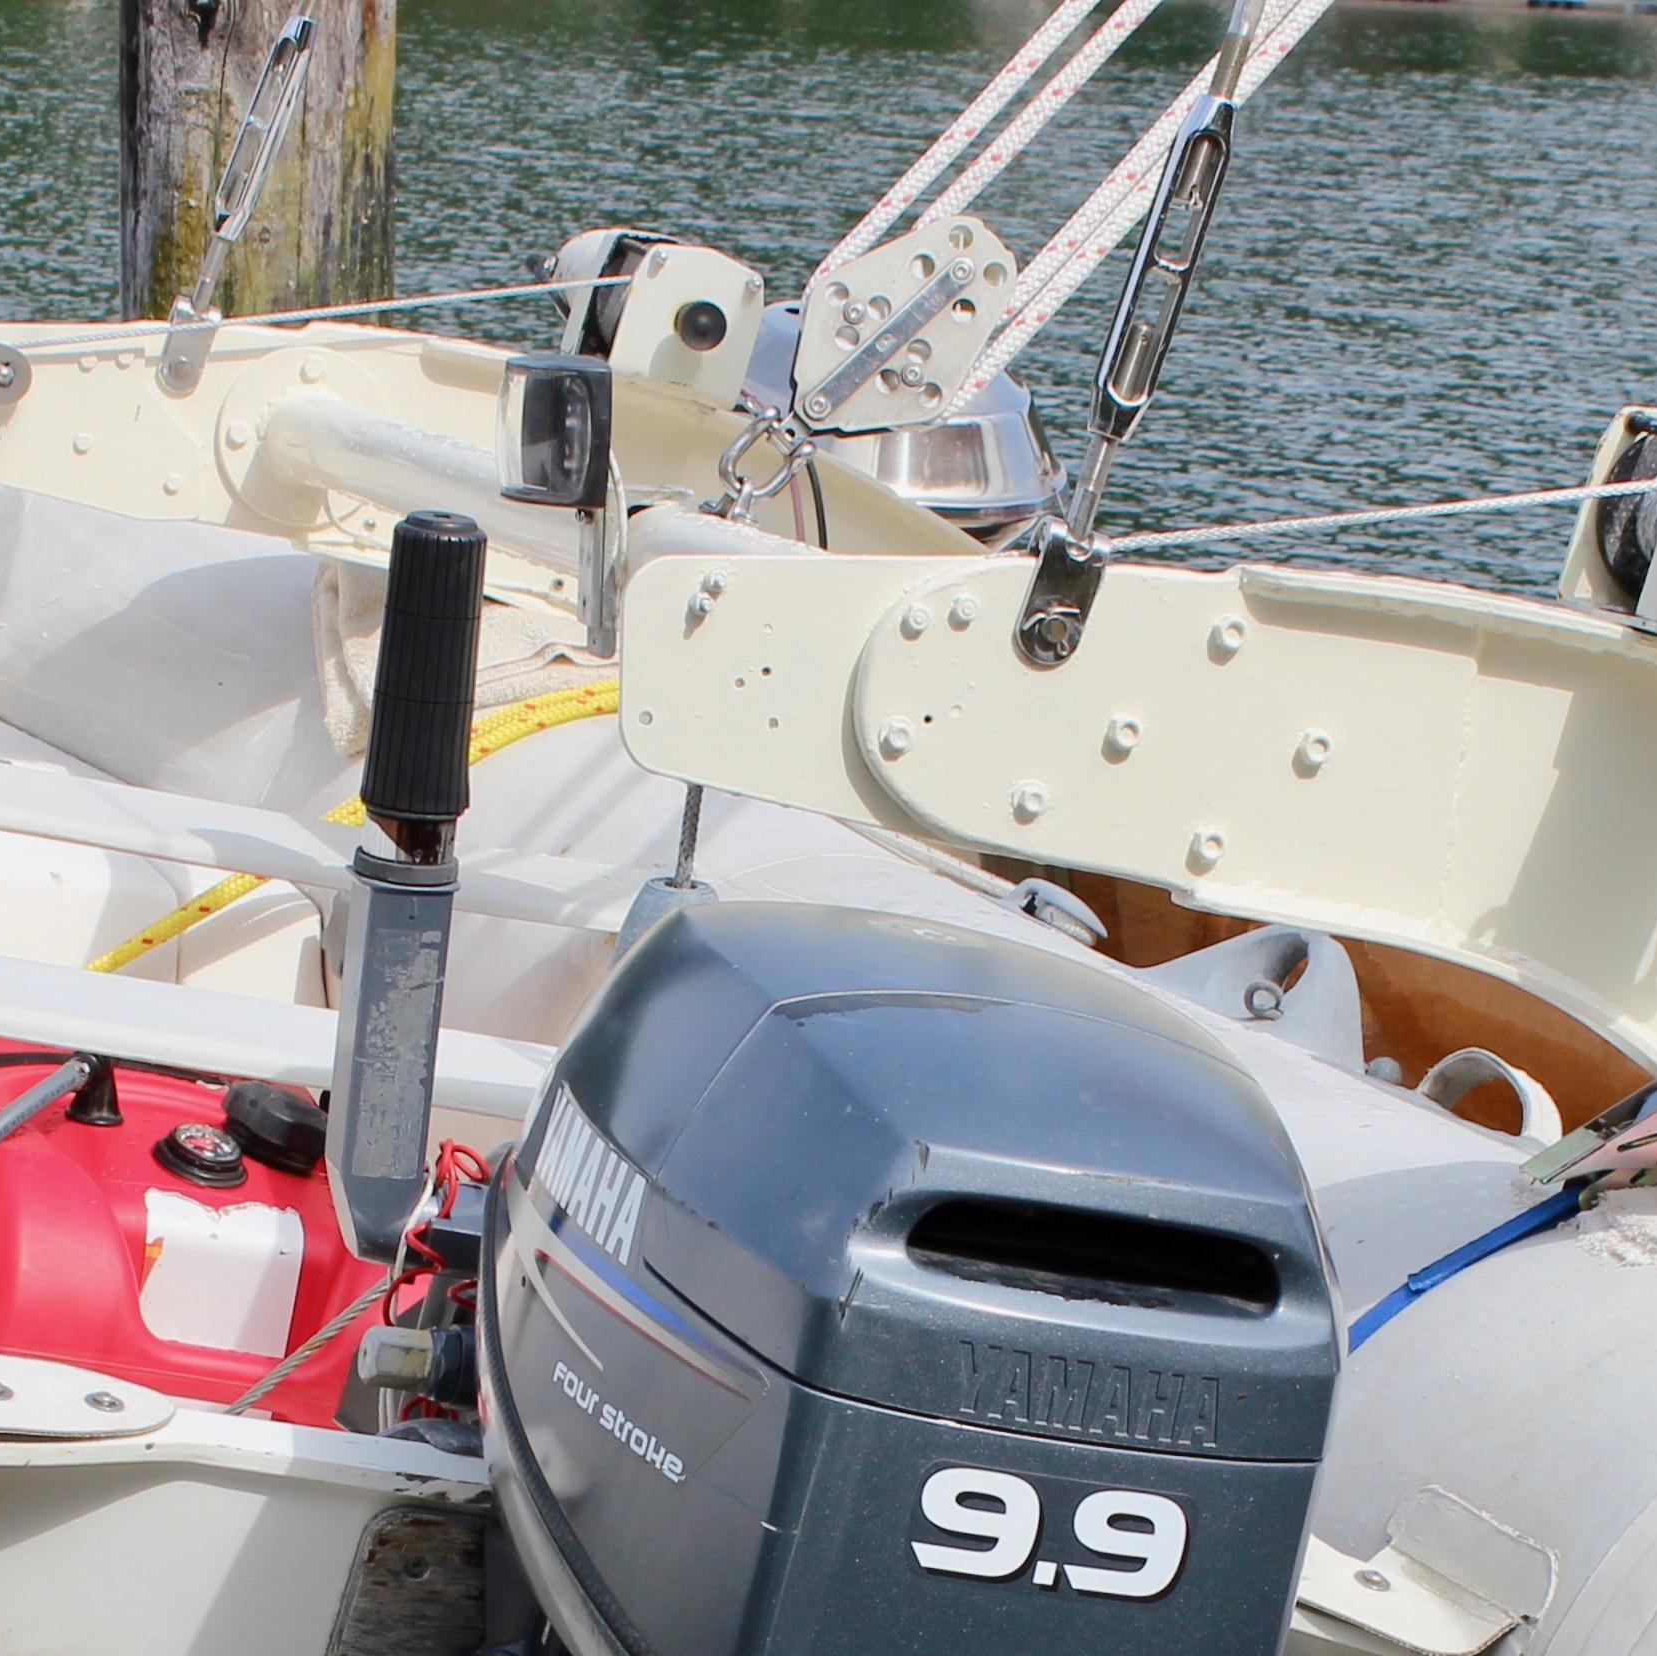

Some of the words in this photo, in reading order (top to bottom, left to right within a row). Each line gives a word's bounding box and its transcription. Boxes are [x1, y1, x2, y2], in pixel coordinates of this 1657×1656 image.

[535, 1086, 647, 1266] YAMAHA
[959, 1340, 1220, 1448] YAMAHA
[910, 1467, 1187, 1597] 9.9
